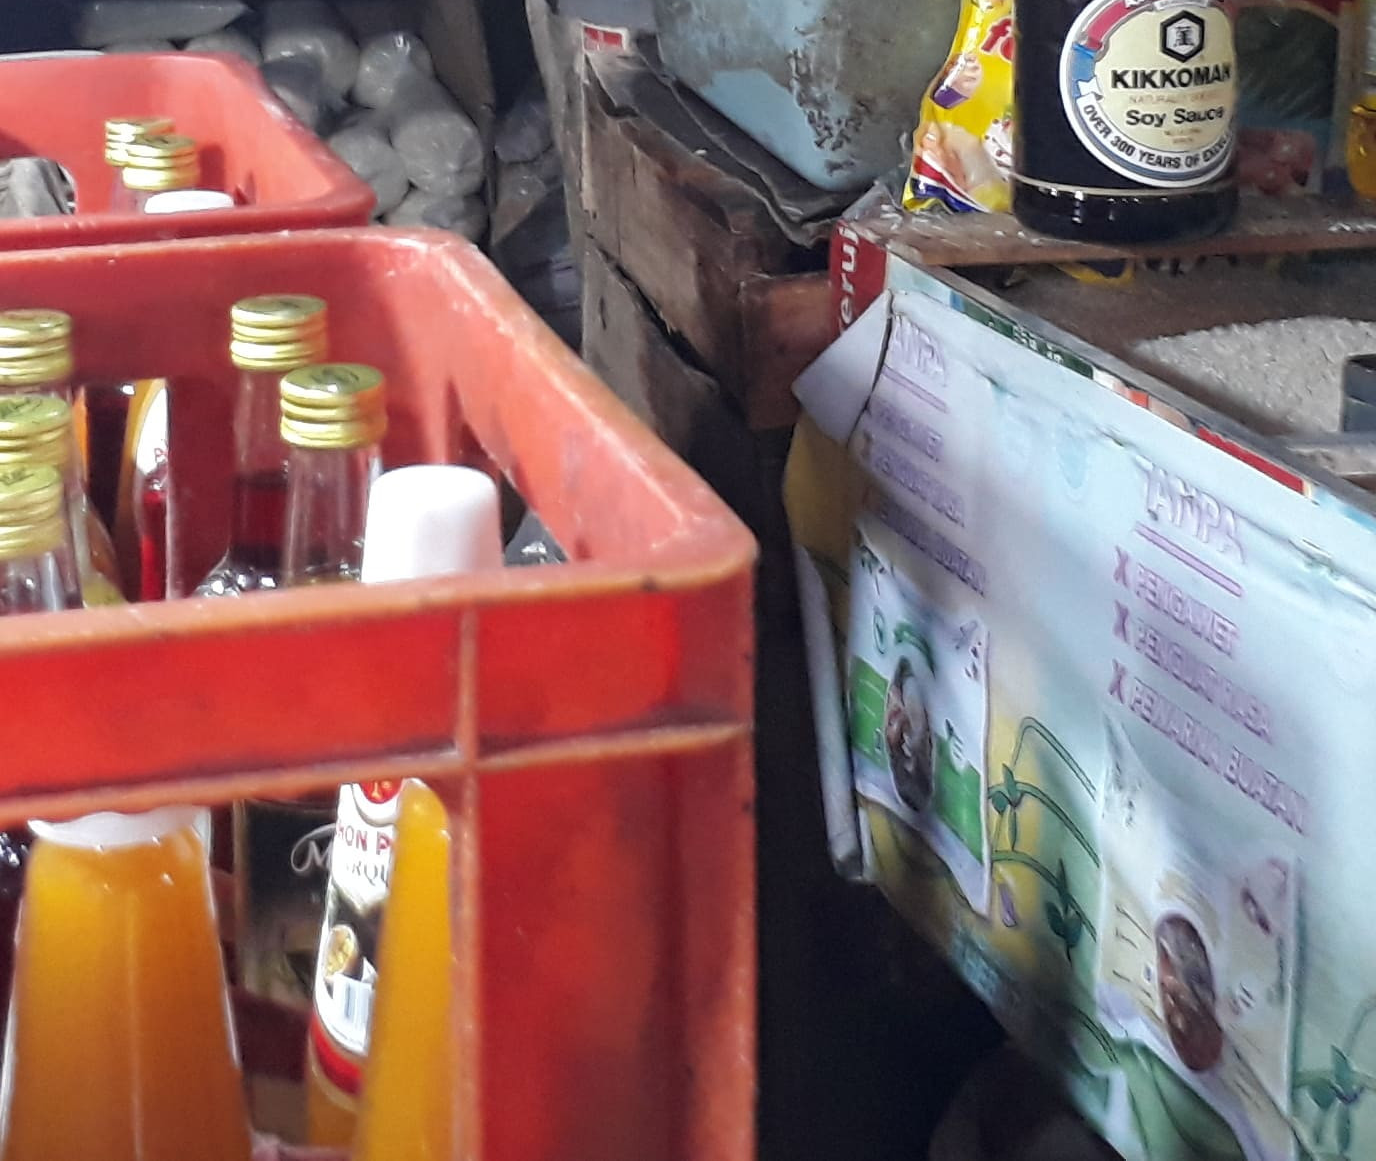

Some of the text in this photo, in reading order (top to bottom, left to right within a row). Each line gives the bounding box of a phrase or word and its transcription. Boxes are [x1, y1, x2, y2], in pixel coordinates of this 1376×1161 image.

[1083, 104, 1113, 141] OVER
[1110, 135, 1136, 157] 300
[1138, 149, 1181, 169] YEARS
[1185, 153, 1201, 168] OF
[1125, 108, 1167, 128] Soy
